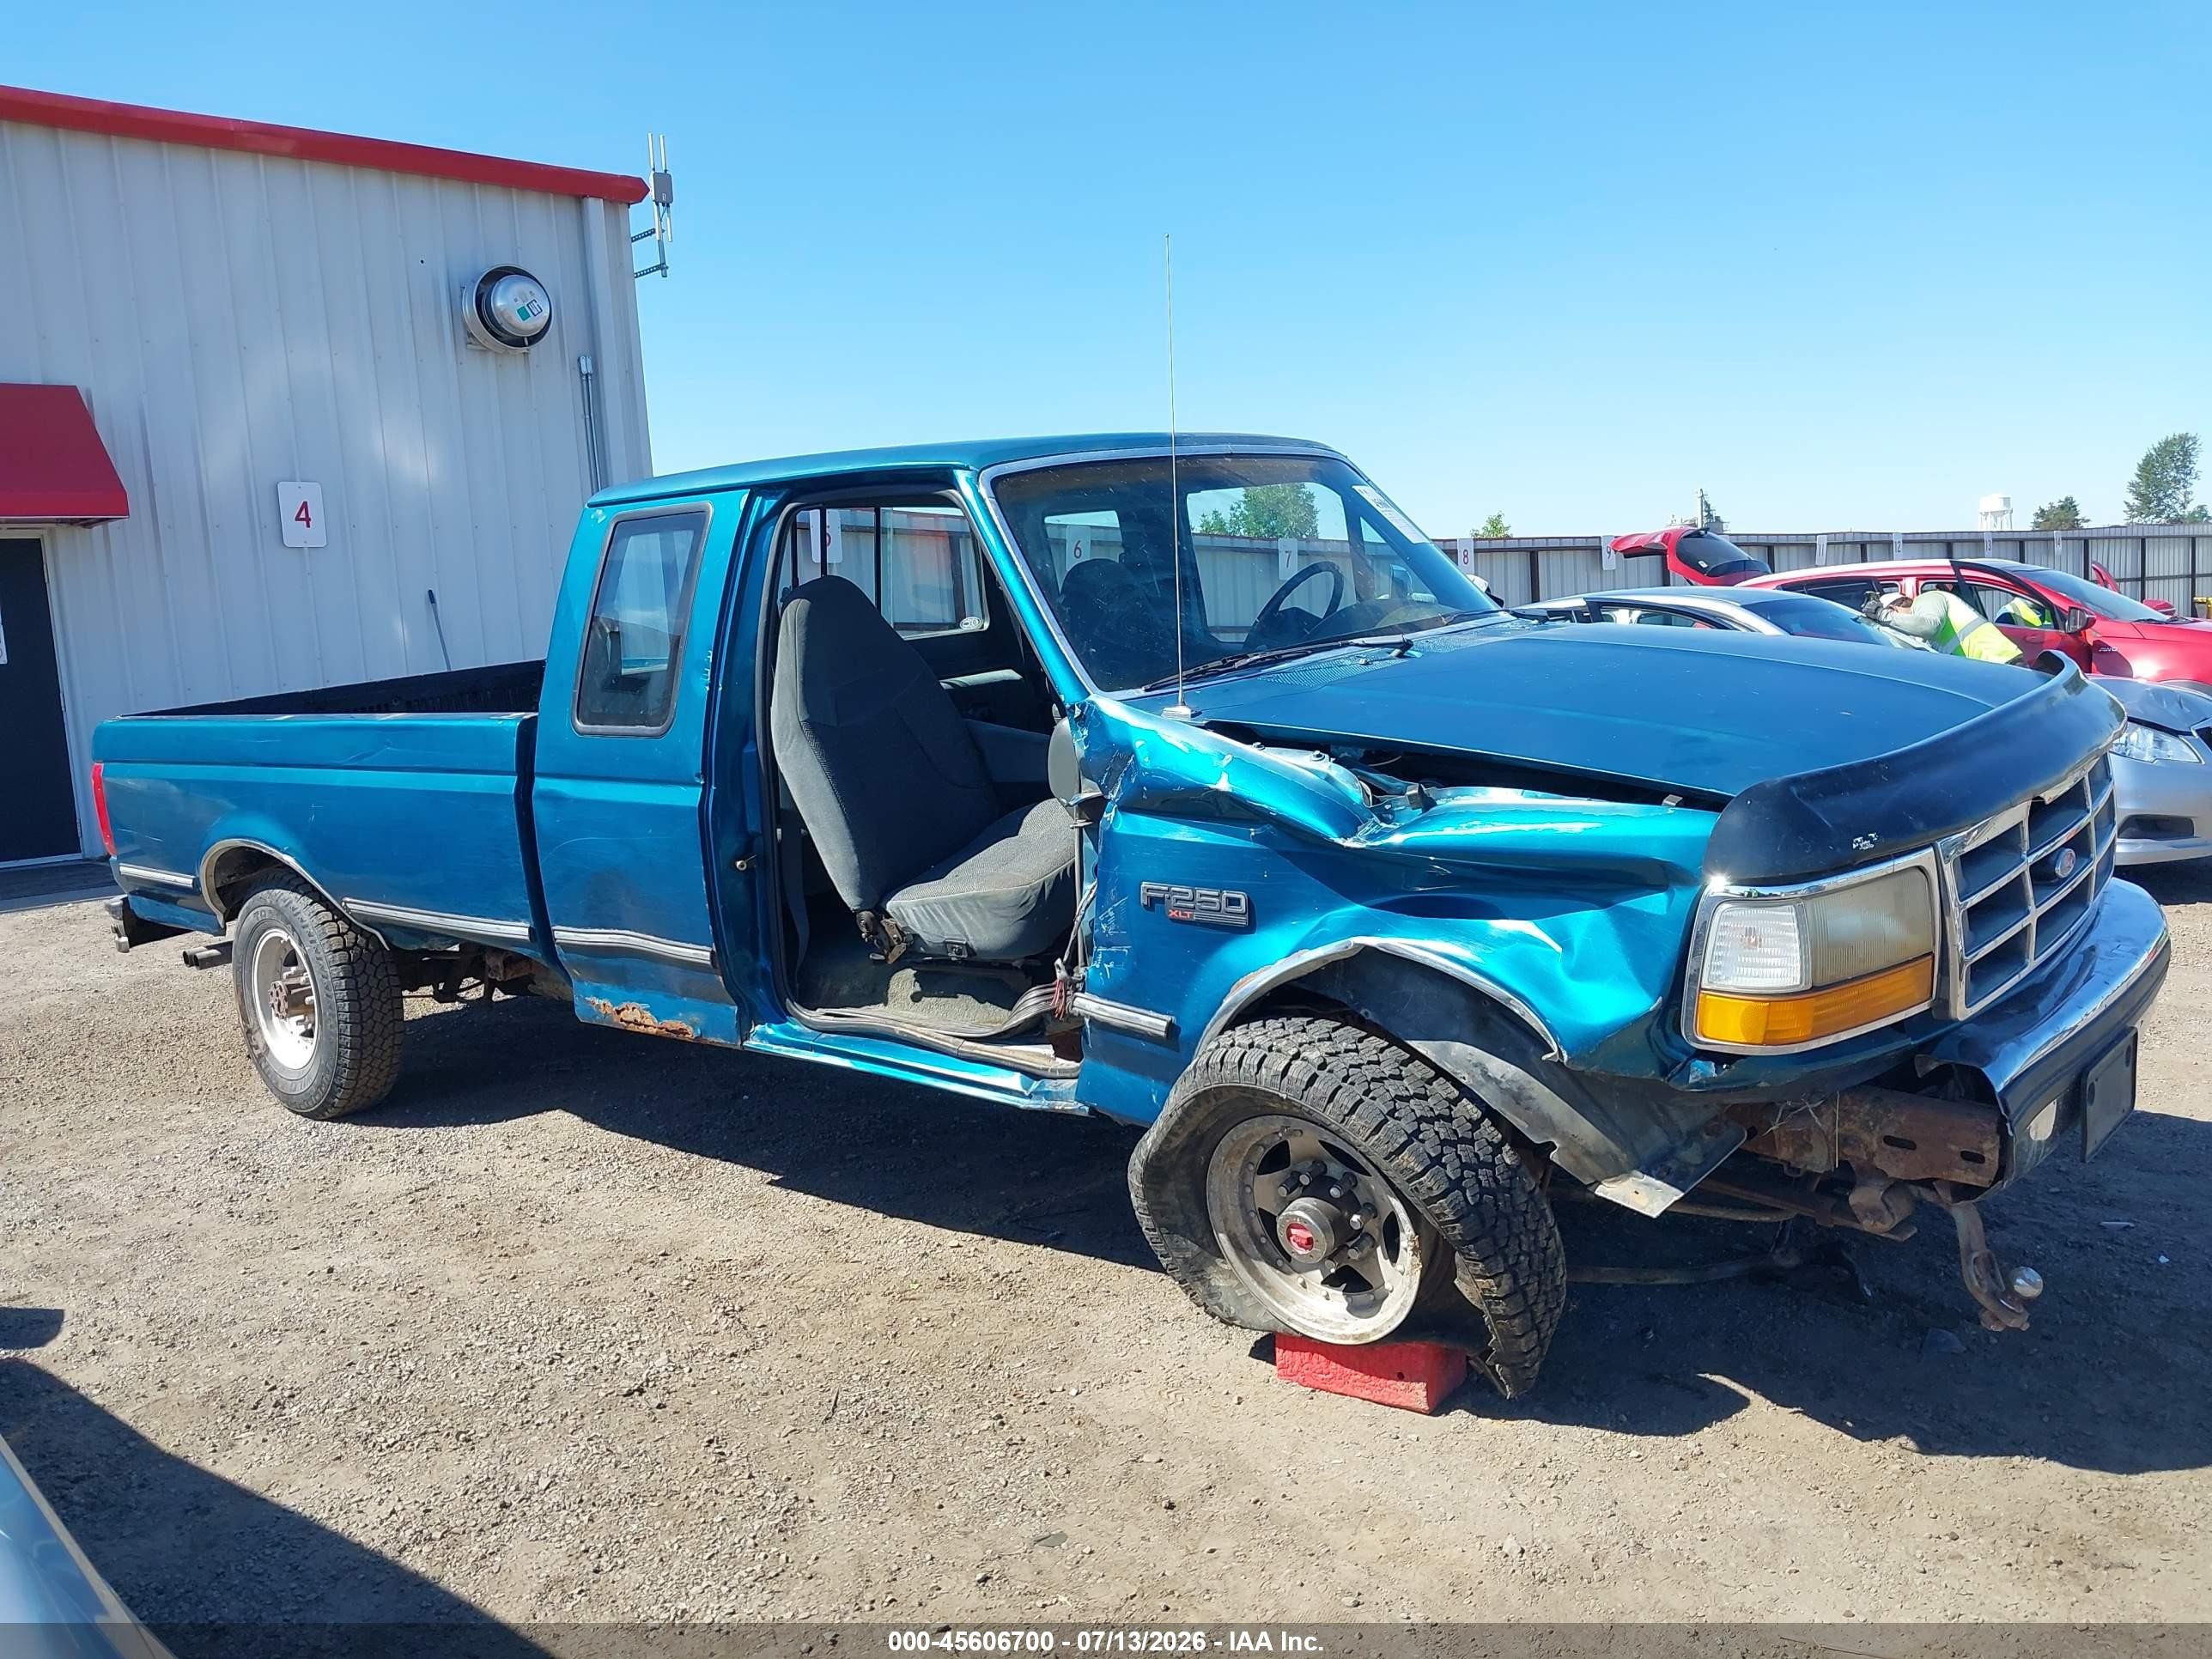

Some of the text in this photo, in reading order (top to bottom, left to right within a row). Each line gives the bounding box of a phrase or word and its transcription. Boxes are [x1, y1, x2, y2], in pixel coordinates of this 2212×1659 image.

[295, 501, 312, 528] 4
[1073, 540, 1082, 559] 6
[1606, 544, 1612, 559] 9
[1818, 542, 1825, 557] 11
[1894, 540, 1901, 553] 12
[1985, 539, 1991, 551] 13
[1285, 550, 1292, 568] 7
[1462, 549, 1469, 565] 8
[1168, 909, 1193, 920] XLT
